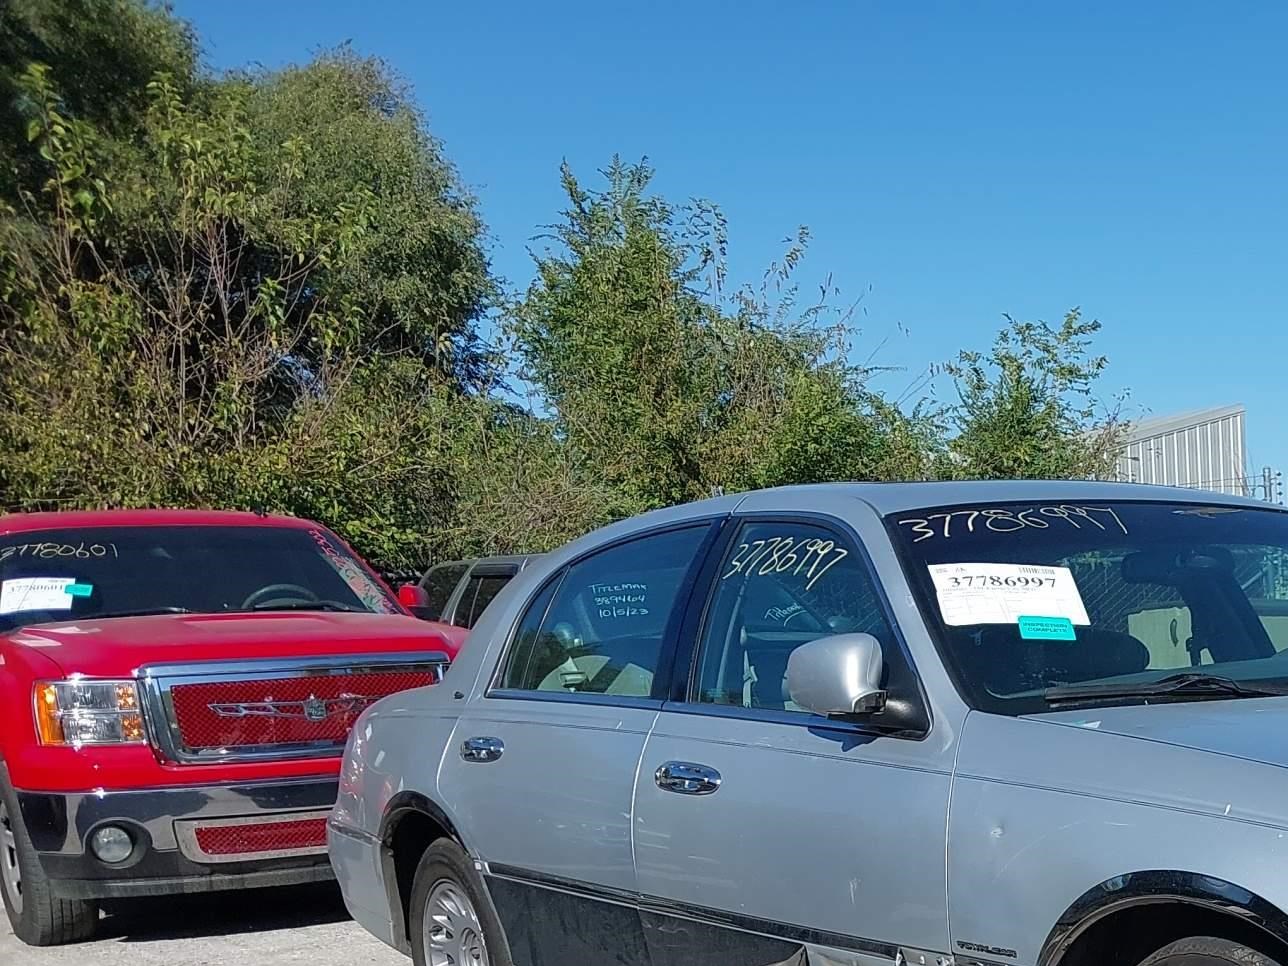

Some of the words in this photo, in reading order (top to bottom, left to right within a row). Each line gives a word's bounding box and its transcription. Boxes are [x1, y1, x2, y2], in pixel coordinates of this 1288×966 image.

[898, 504, 1128, 542] 37786997
[722, 535, 848, 592] 37786997
[948, 575, 1056, 588] 37786997
[599, 606, 649, 618] 10/5/23
